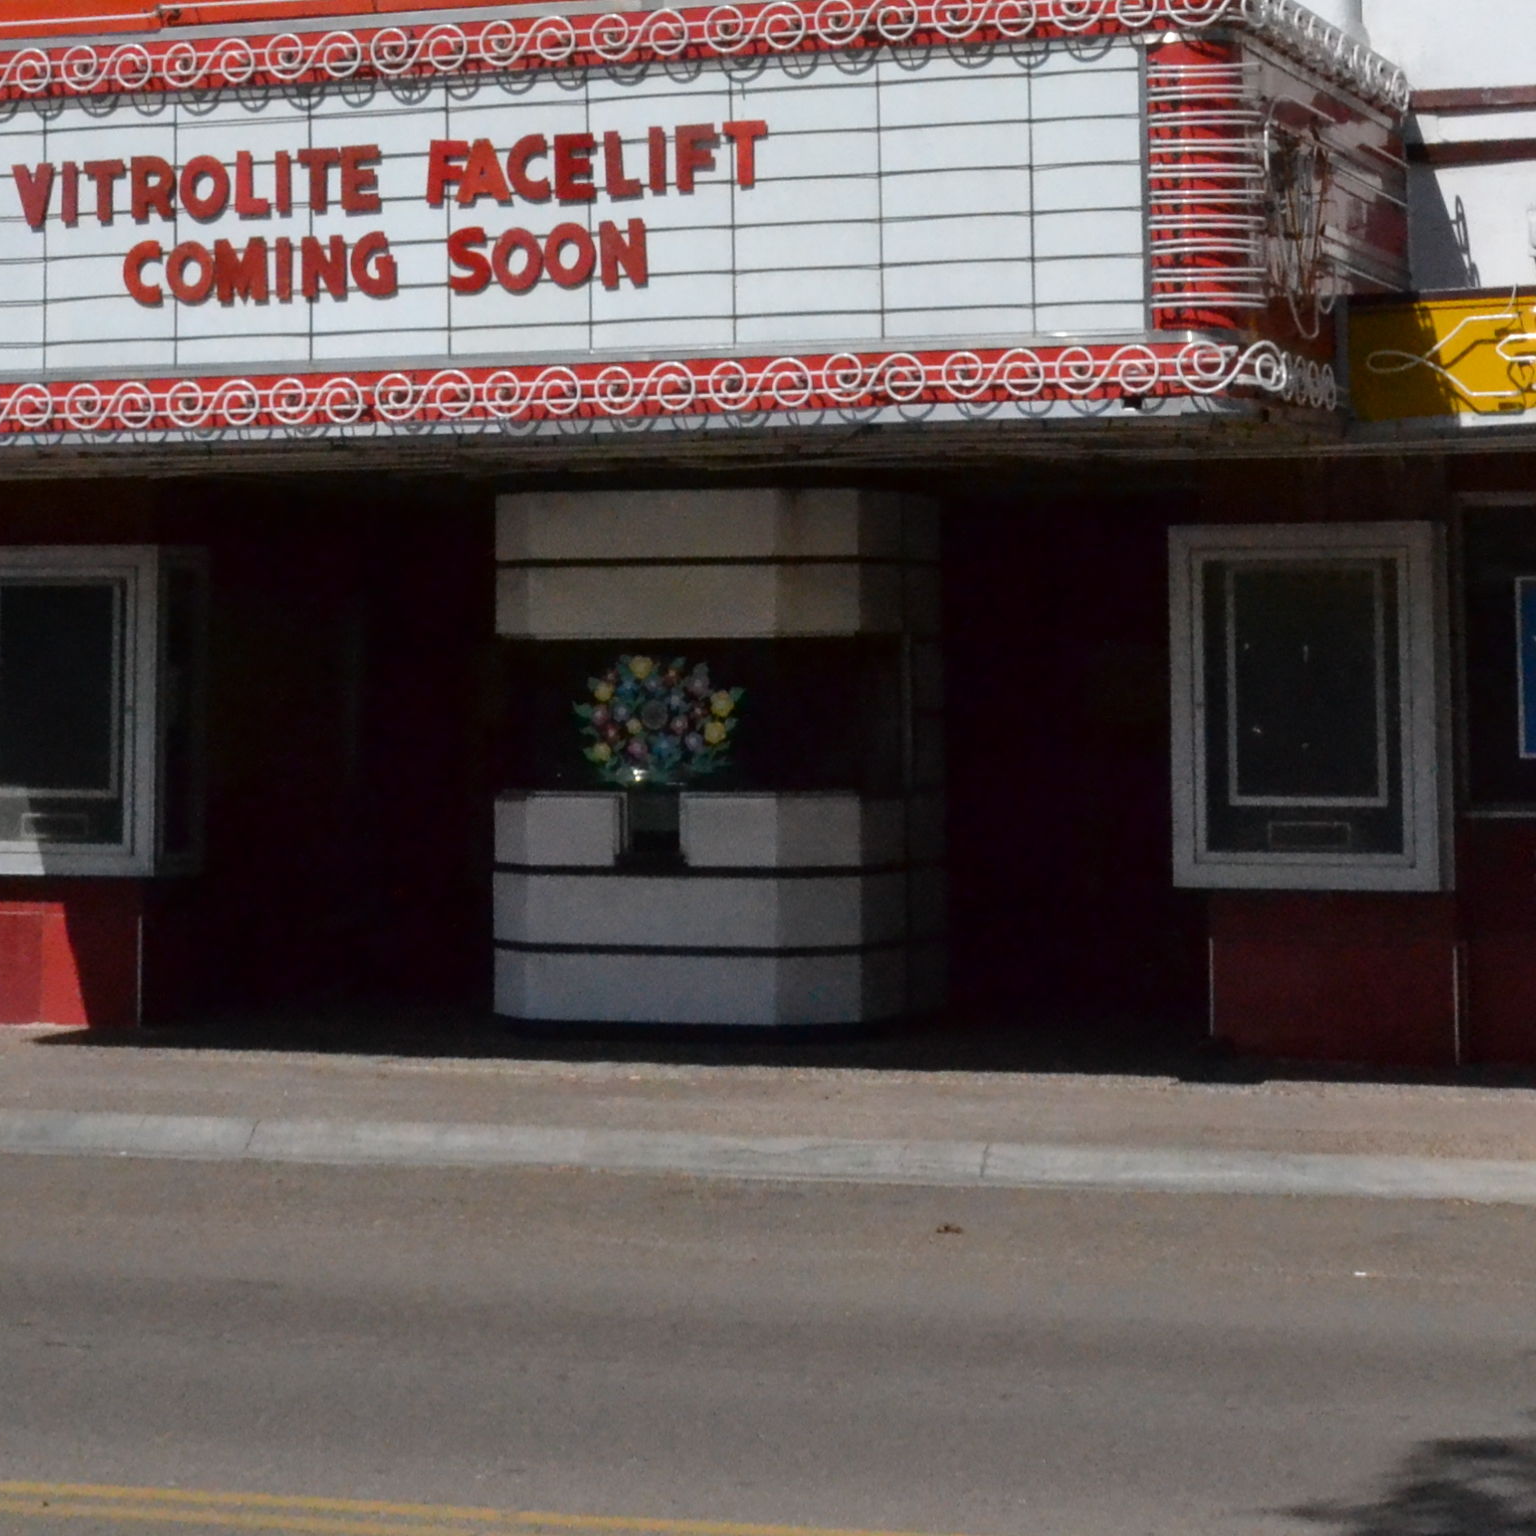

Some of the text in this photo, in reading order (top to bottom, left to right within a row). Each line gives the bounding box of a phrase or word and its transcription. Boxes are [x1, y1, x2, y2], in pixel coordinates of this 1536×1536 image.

[12, 120, 768, 230] VITROLITE FACELIFT
[123, 217, 649, 305] COMING SOON
